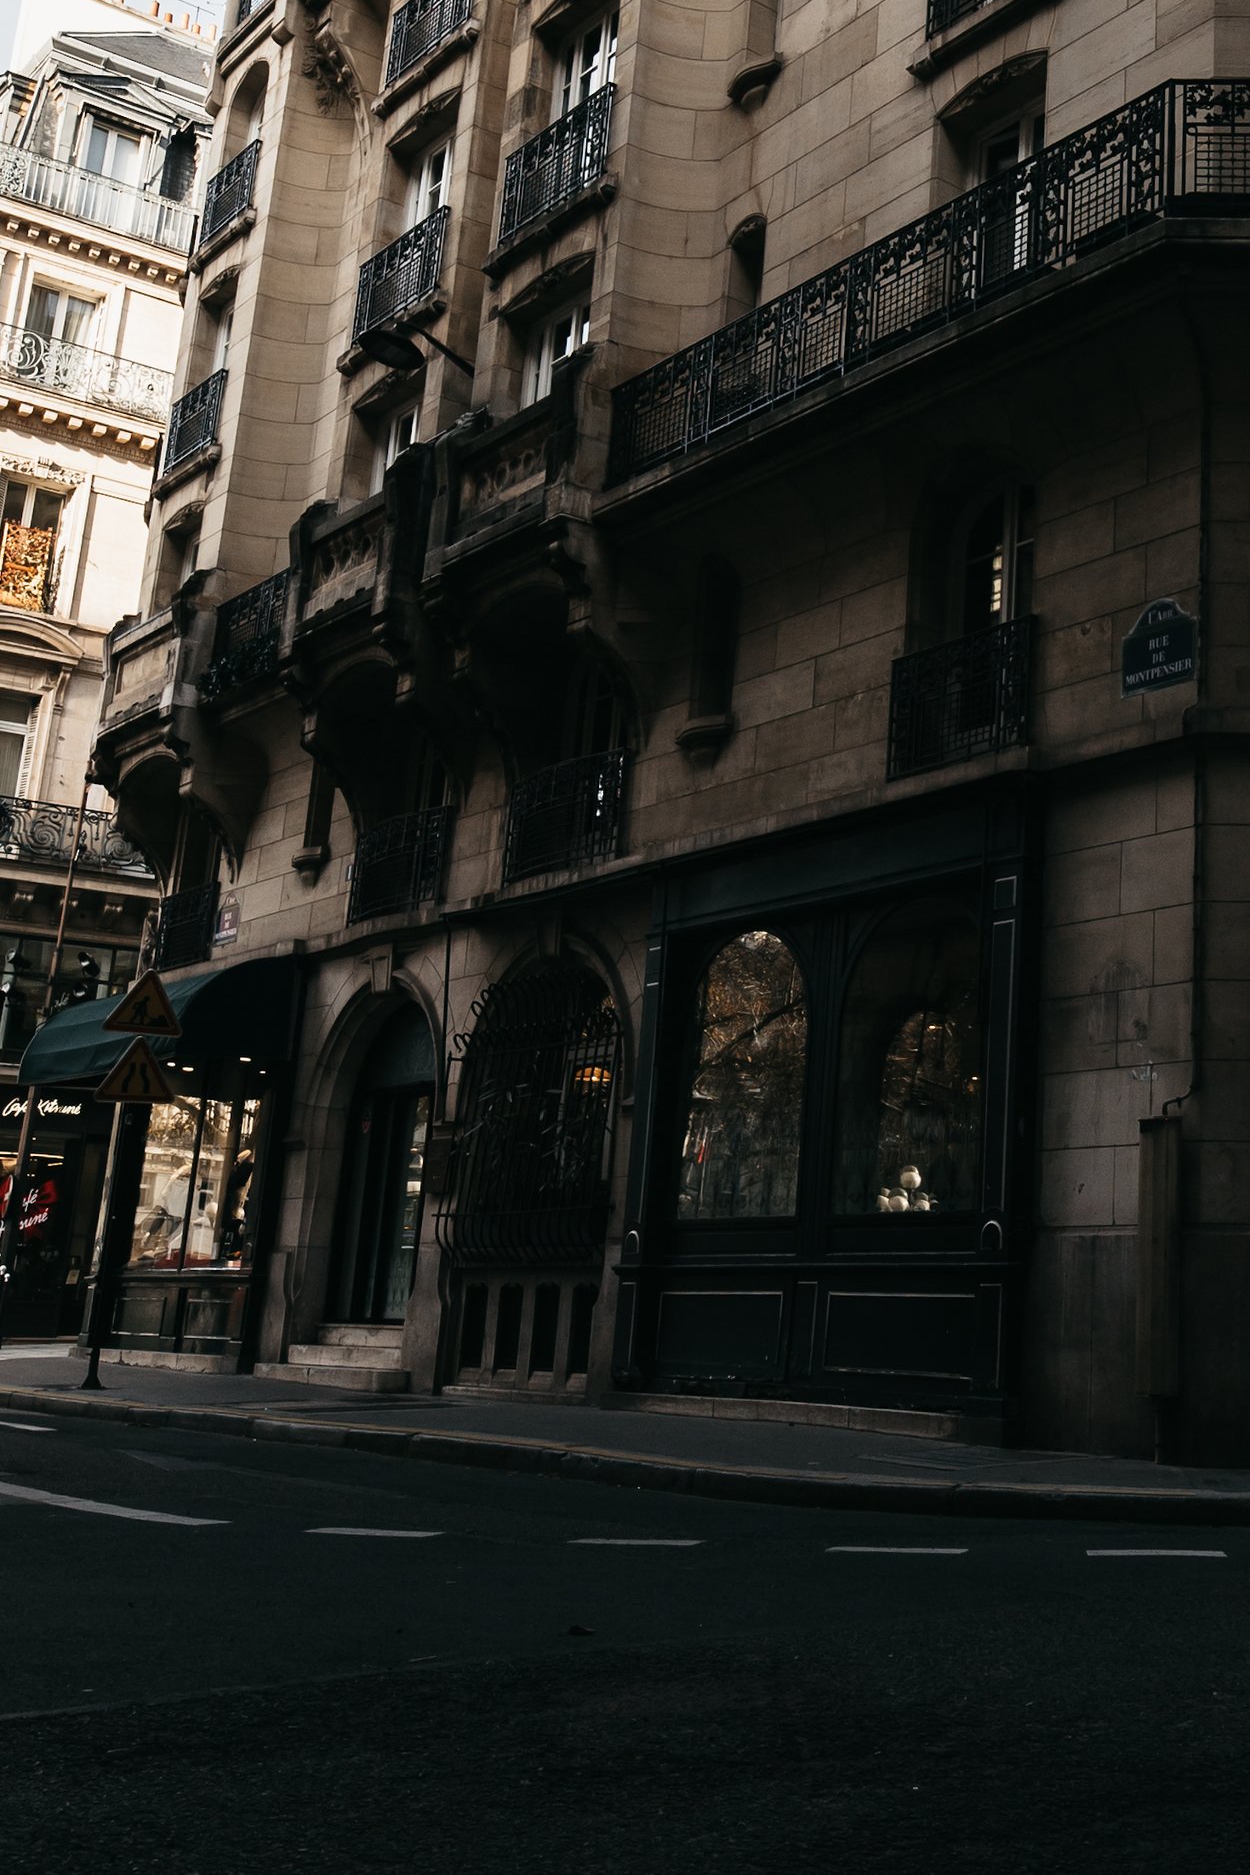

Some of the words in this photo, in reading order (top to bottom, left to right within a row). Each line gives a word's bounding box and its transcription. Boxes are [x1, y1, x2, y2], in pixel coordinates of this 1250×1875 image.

[1148, 634, 1170, 651] RUE
[1152, 650, 1166, 665] DE
[1125, 657, 1192, 686] MONTPENSIER
[19, 1207, 50, 1231] suné
